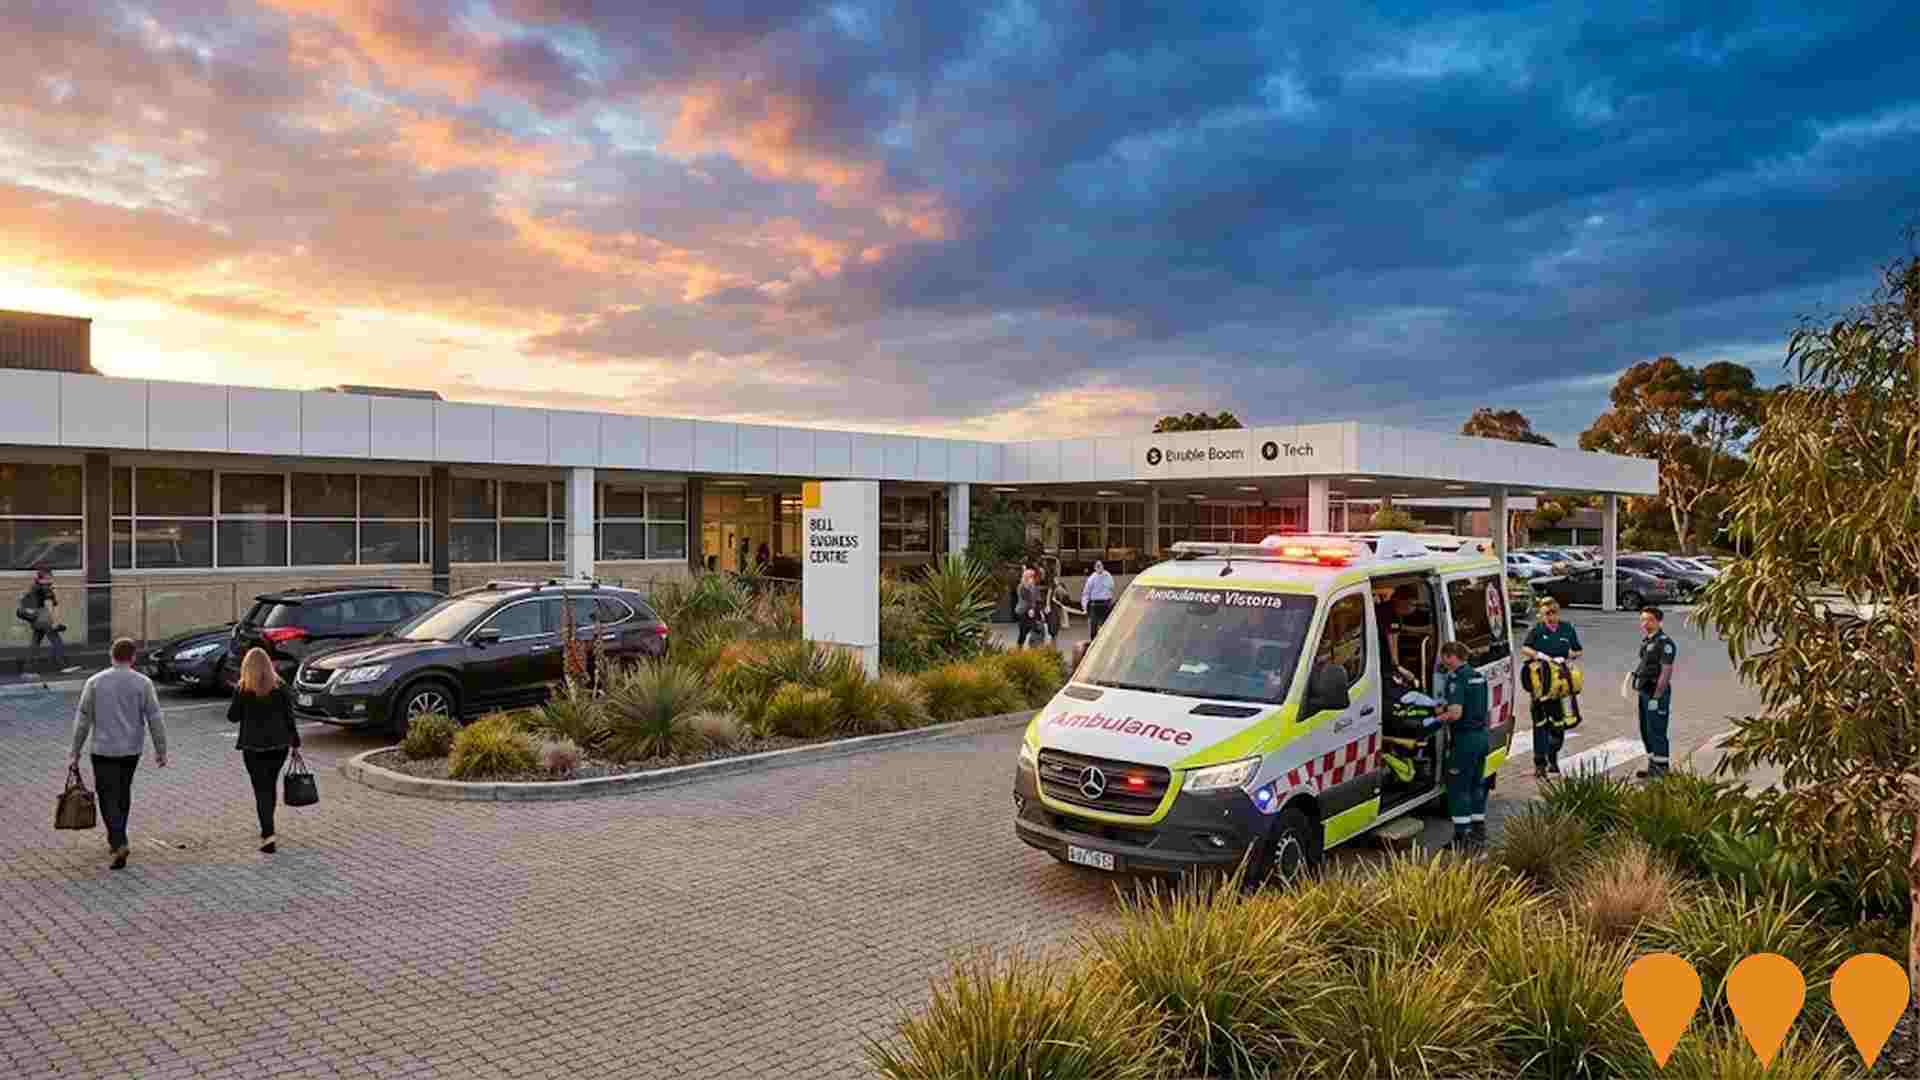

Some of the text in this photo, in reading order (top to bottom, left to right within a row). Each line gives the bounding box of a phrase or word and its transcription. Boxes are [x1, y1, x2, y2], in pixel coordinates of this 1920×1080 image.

[1208, 447, 1246, 461] Boom
[1282, 443, 1314, 457] Tech
[809, 551, 849, 564] CENTRE
[1145, 589, 1283, 608] Ambulance Victoria
[1051, 711, 1193, 746] Ambulance
